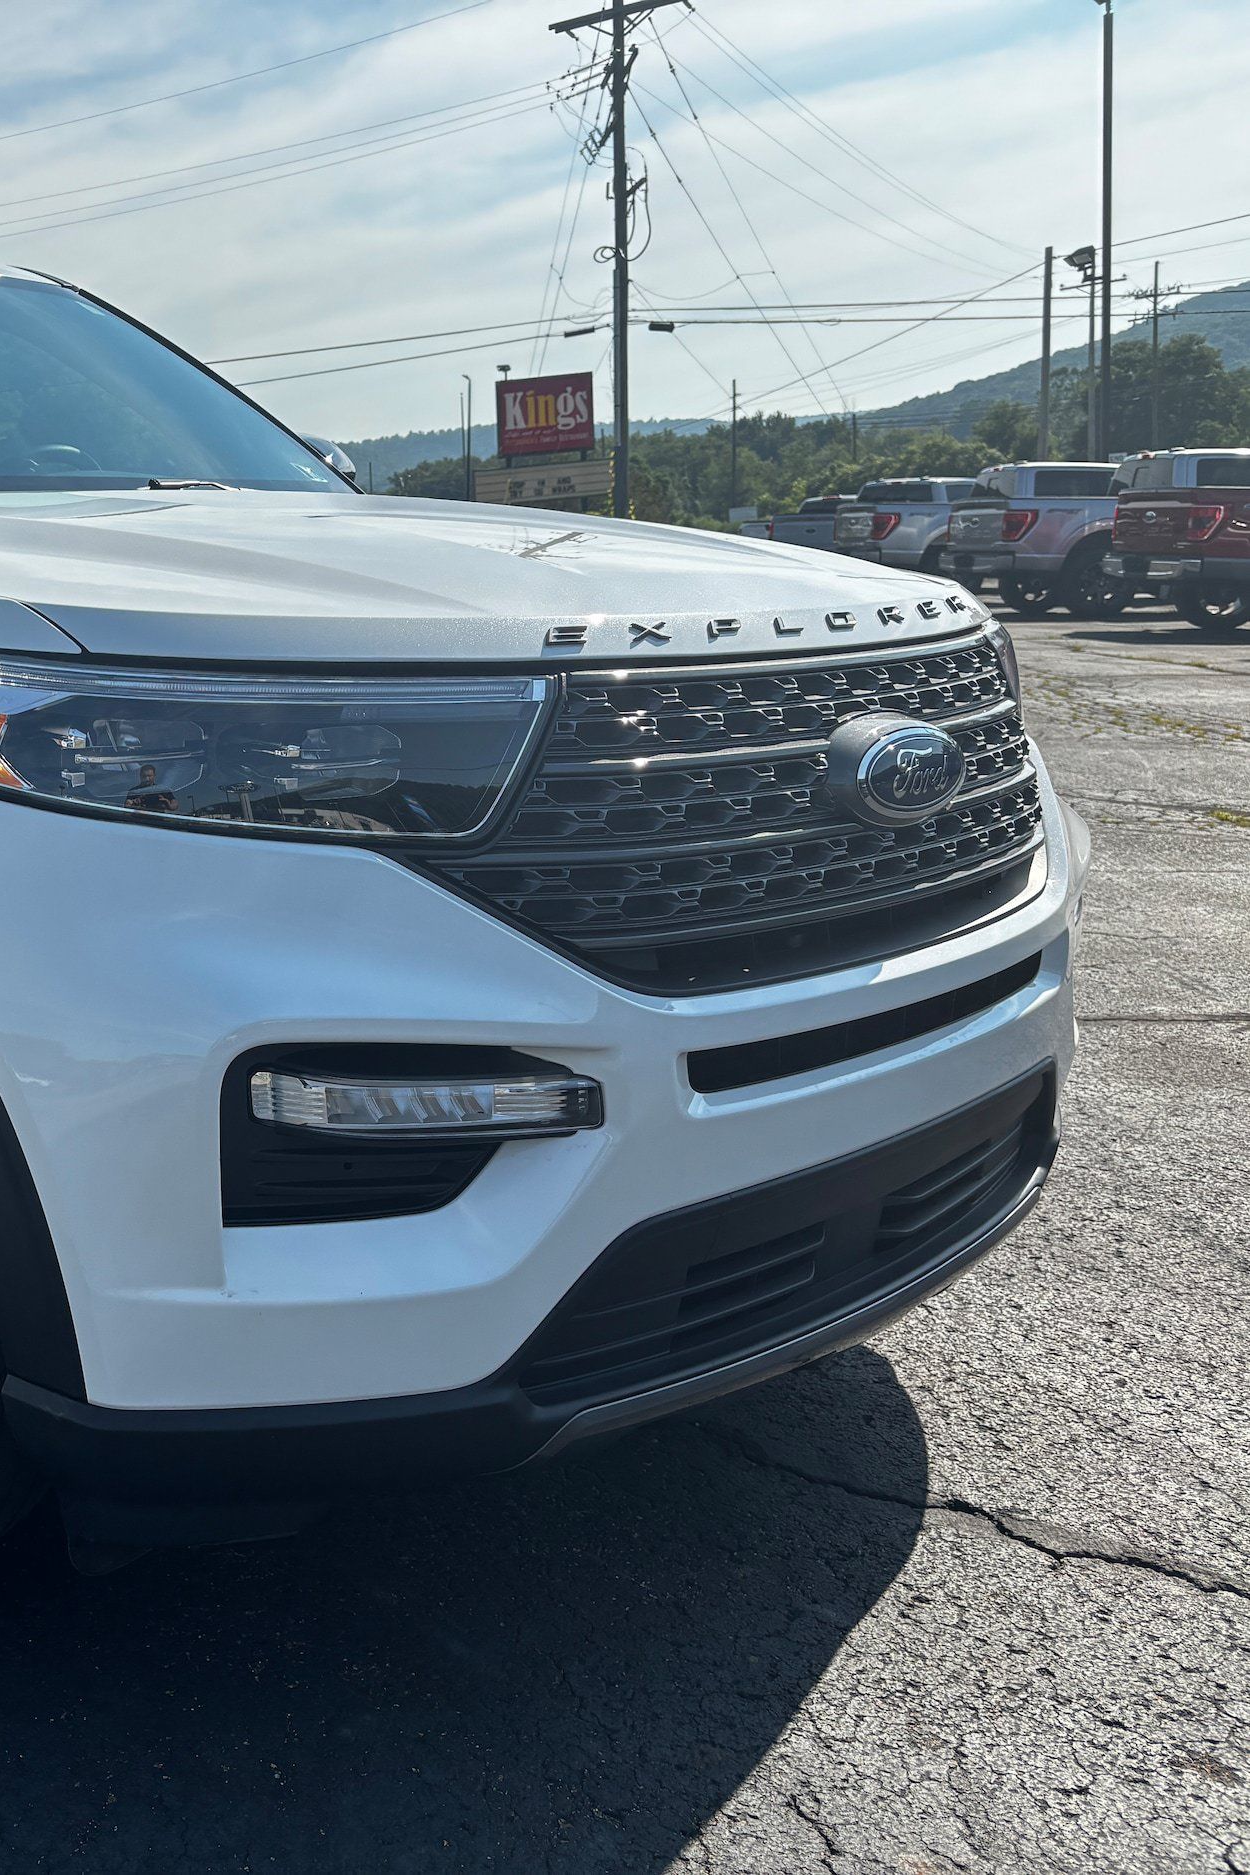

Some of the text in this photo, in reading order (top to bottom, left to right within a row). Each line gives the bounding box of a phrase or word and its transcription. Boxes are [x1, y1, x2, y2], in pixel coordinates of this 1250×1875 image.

[504, 386, 589, 430] Kings
[552, 485, 576, 494] WRAPS
[546, 595, 967, 646] EXPLORER
[893, 747, 949, 798] Ford
